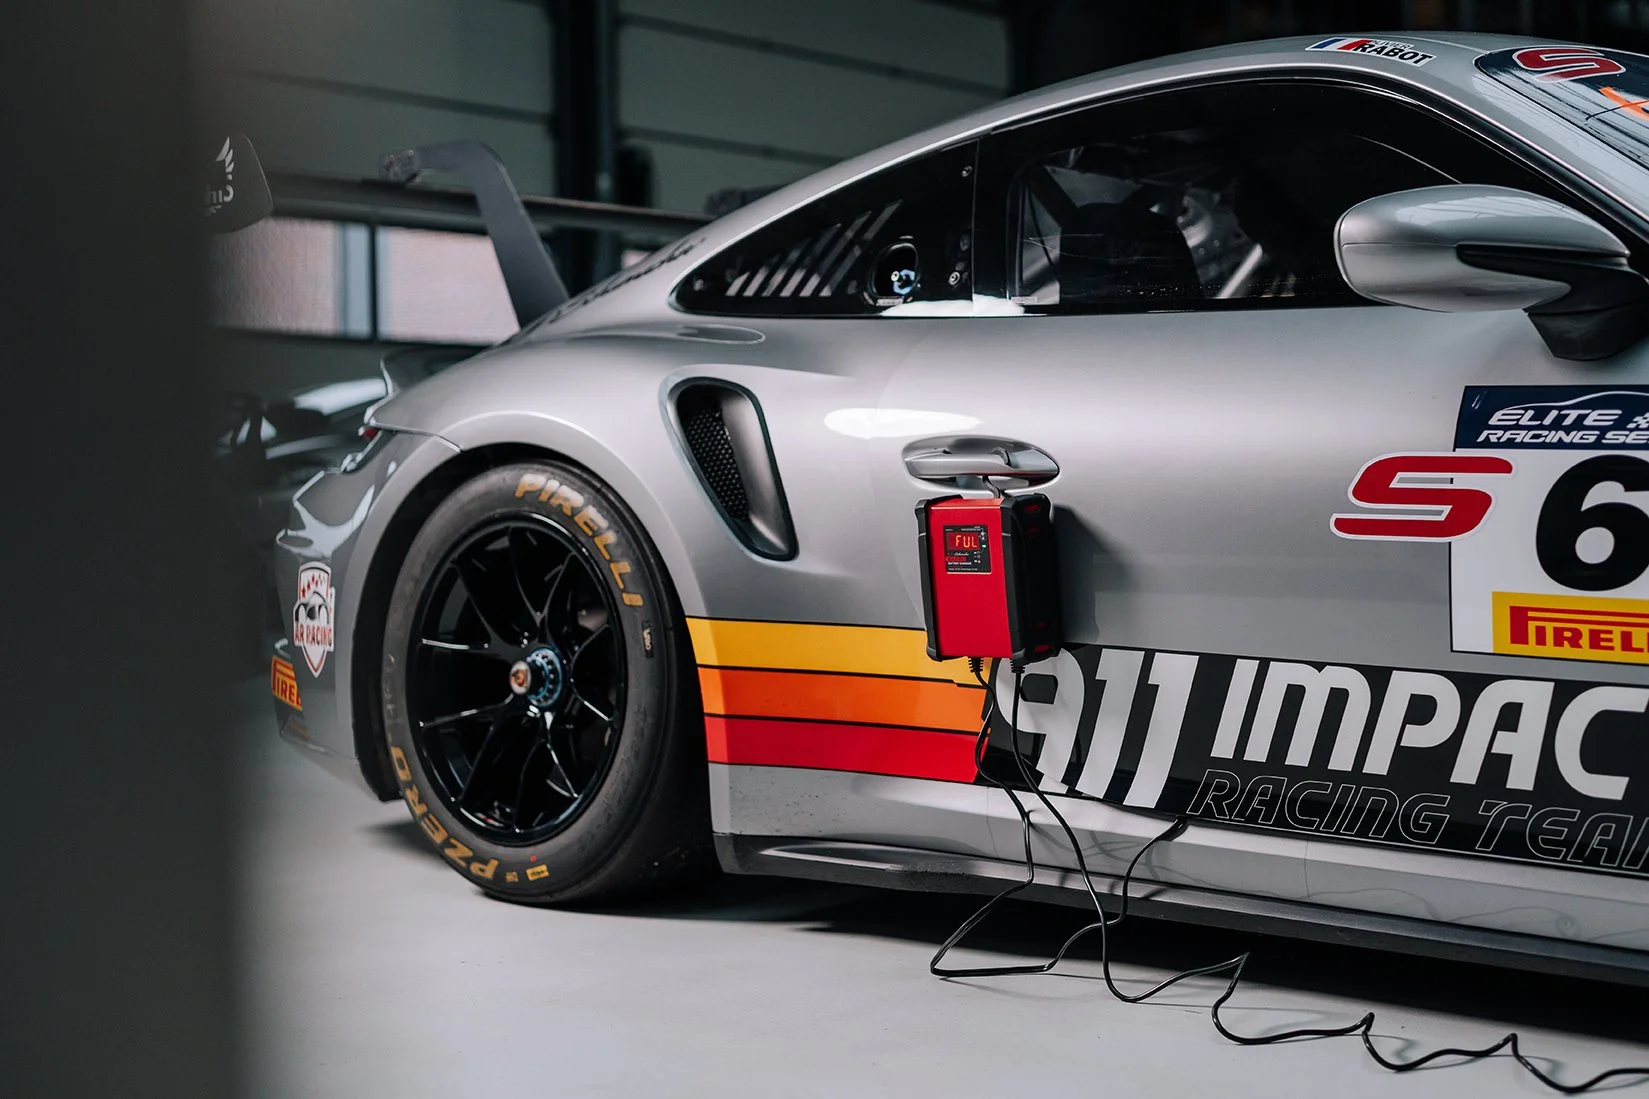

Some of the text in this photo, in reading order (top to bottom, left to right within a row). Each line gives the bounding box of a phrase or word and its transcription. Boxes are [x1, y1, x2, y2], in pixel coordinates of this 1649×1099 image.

[1352, 43, 1433, 65] RABOT
[1476, 430, 1649, 444] RACING SE
[1488, 409, 1623, 426] ELITE
[1331, 453, 1515, 540] S
[515, 473, 644, 606] PIRELLI
[955, 534, 978, 548] FUL
[1536, 454, 1649, 591] 6
[306, 624, 332, 647] RACING
[1509, 605, 1649, 653] PIREL
[996, 648, 1649, 808] 911 IMPAC
[1186, 769, 1451, 844] RACING
